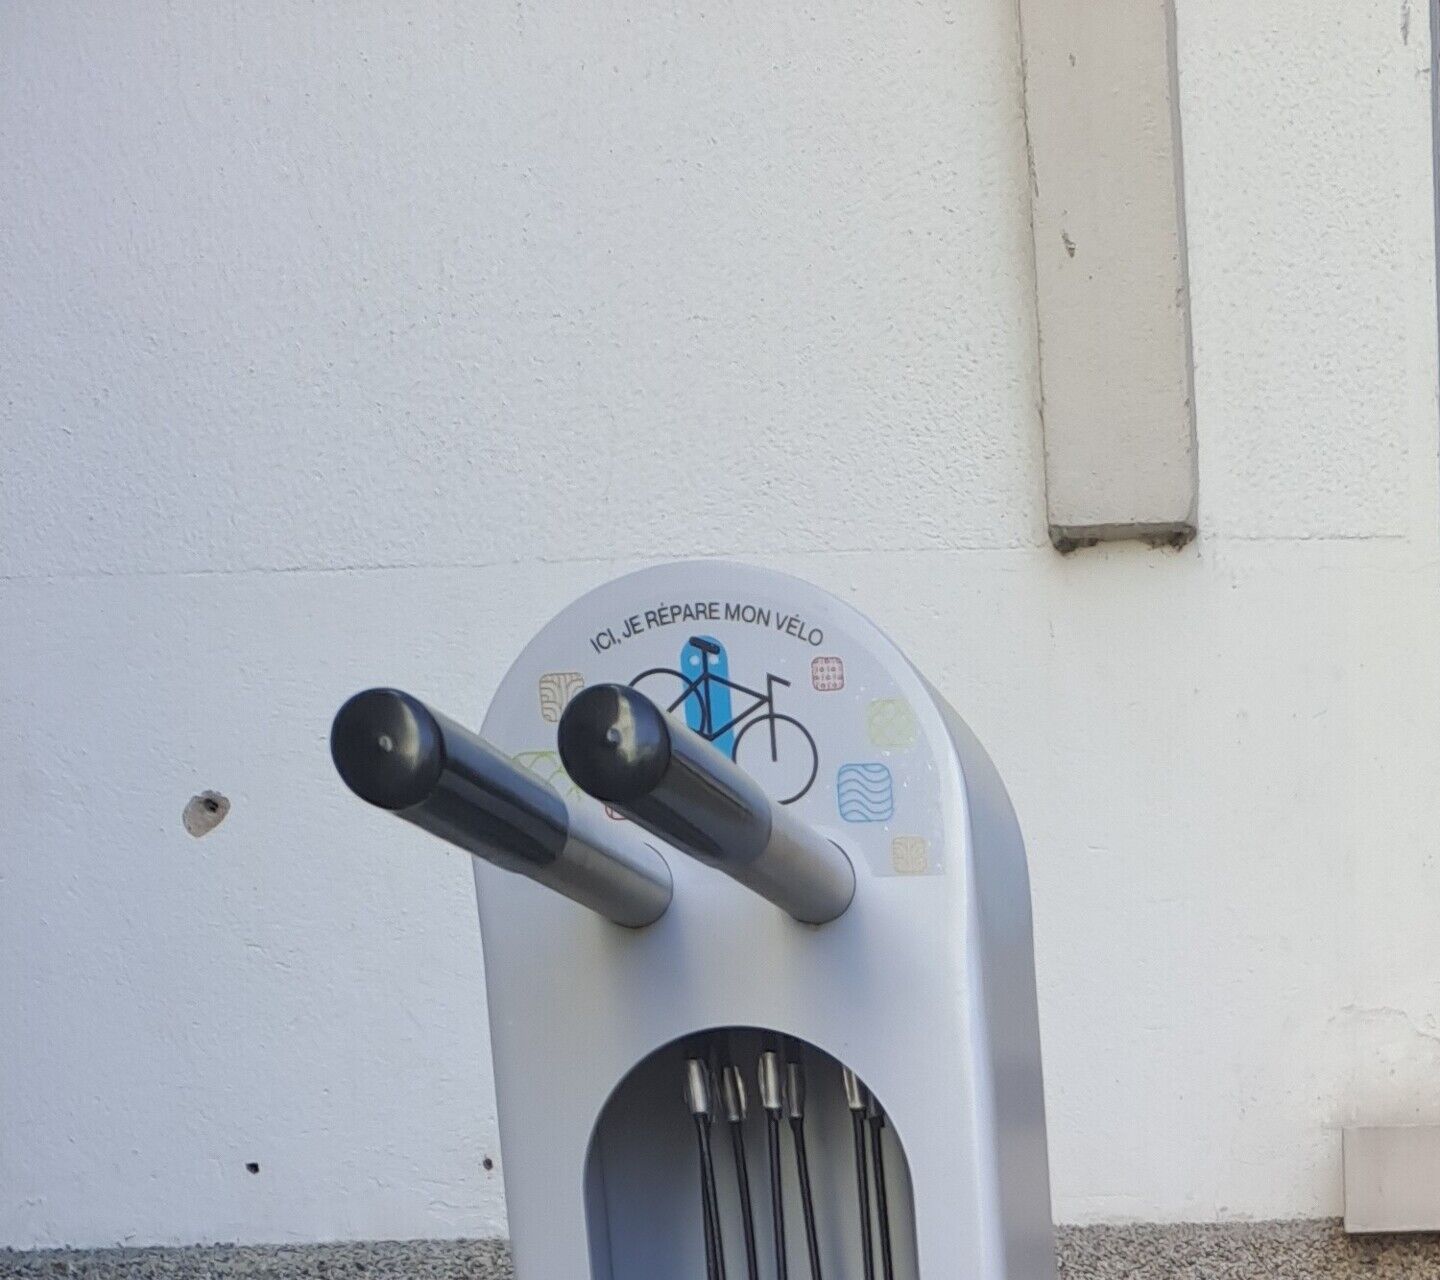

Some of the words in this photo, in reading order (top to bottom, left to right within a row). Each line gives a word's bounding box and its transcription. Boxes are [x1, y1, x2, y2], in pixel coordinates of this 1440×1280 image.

[590, 628, 621, 654] ICI,
[622, 615, 644, 638] JE
[643, 602, 720, 629] RÉPARE
[724, 603, 771, 627] MON
[775, 612, 824, 646] VÉLO
